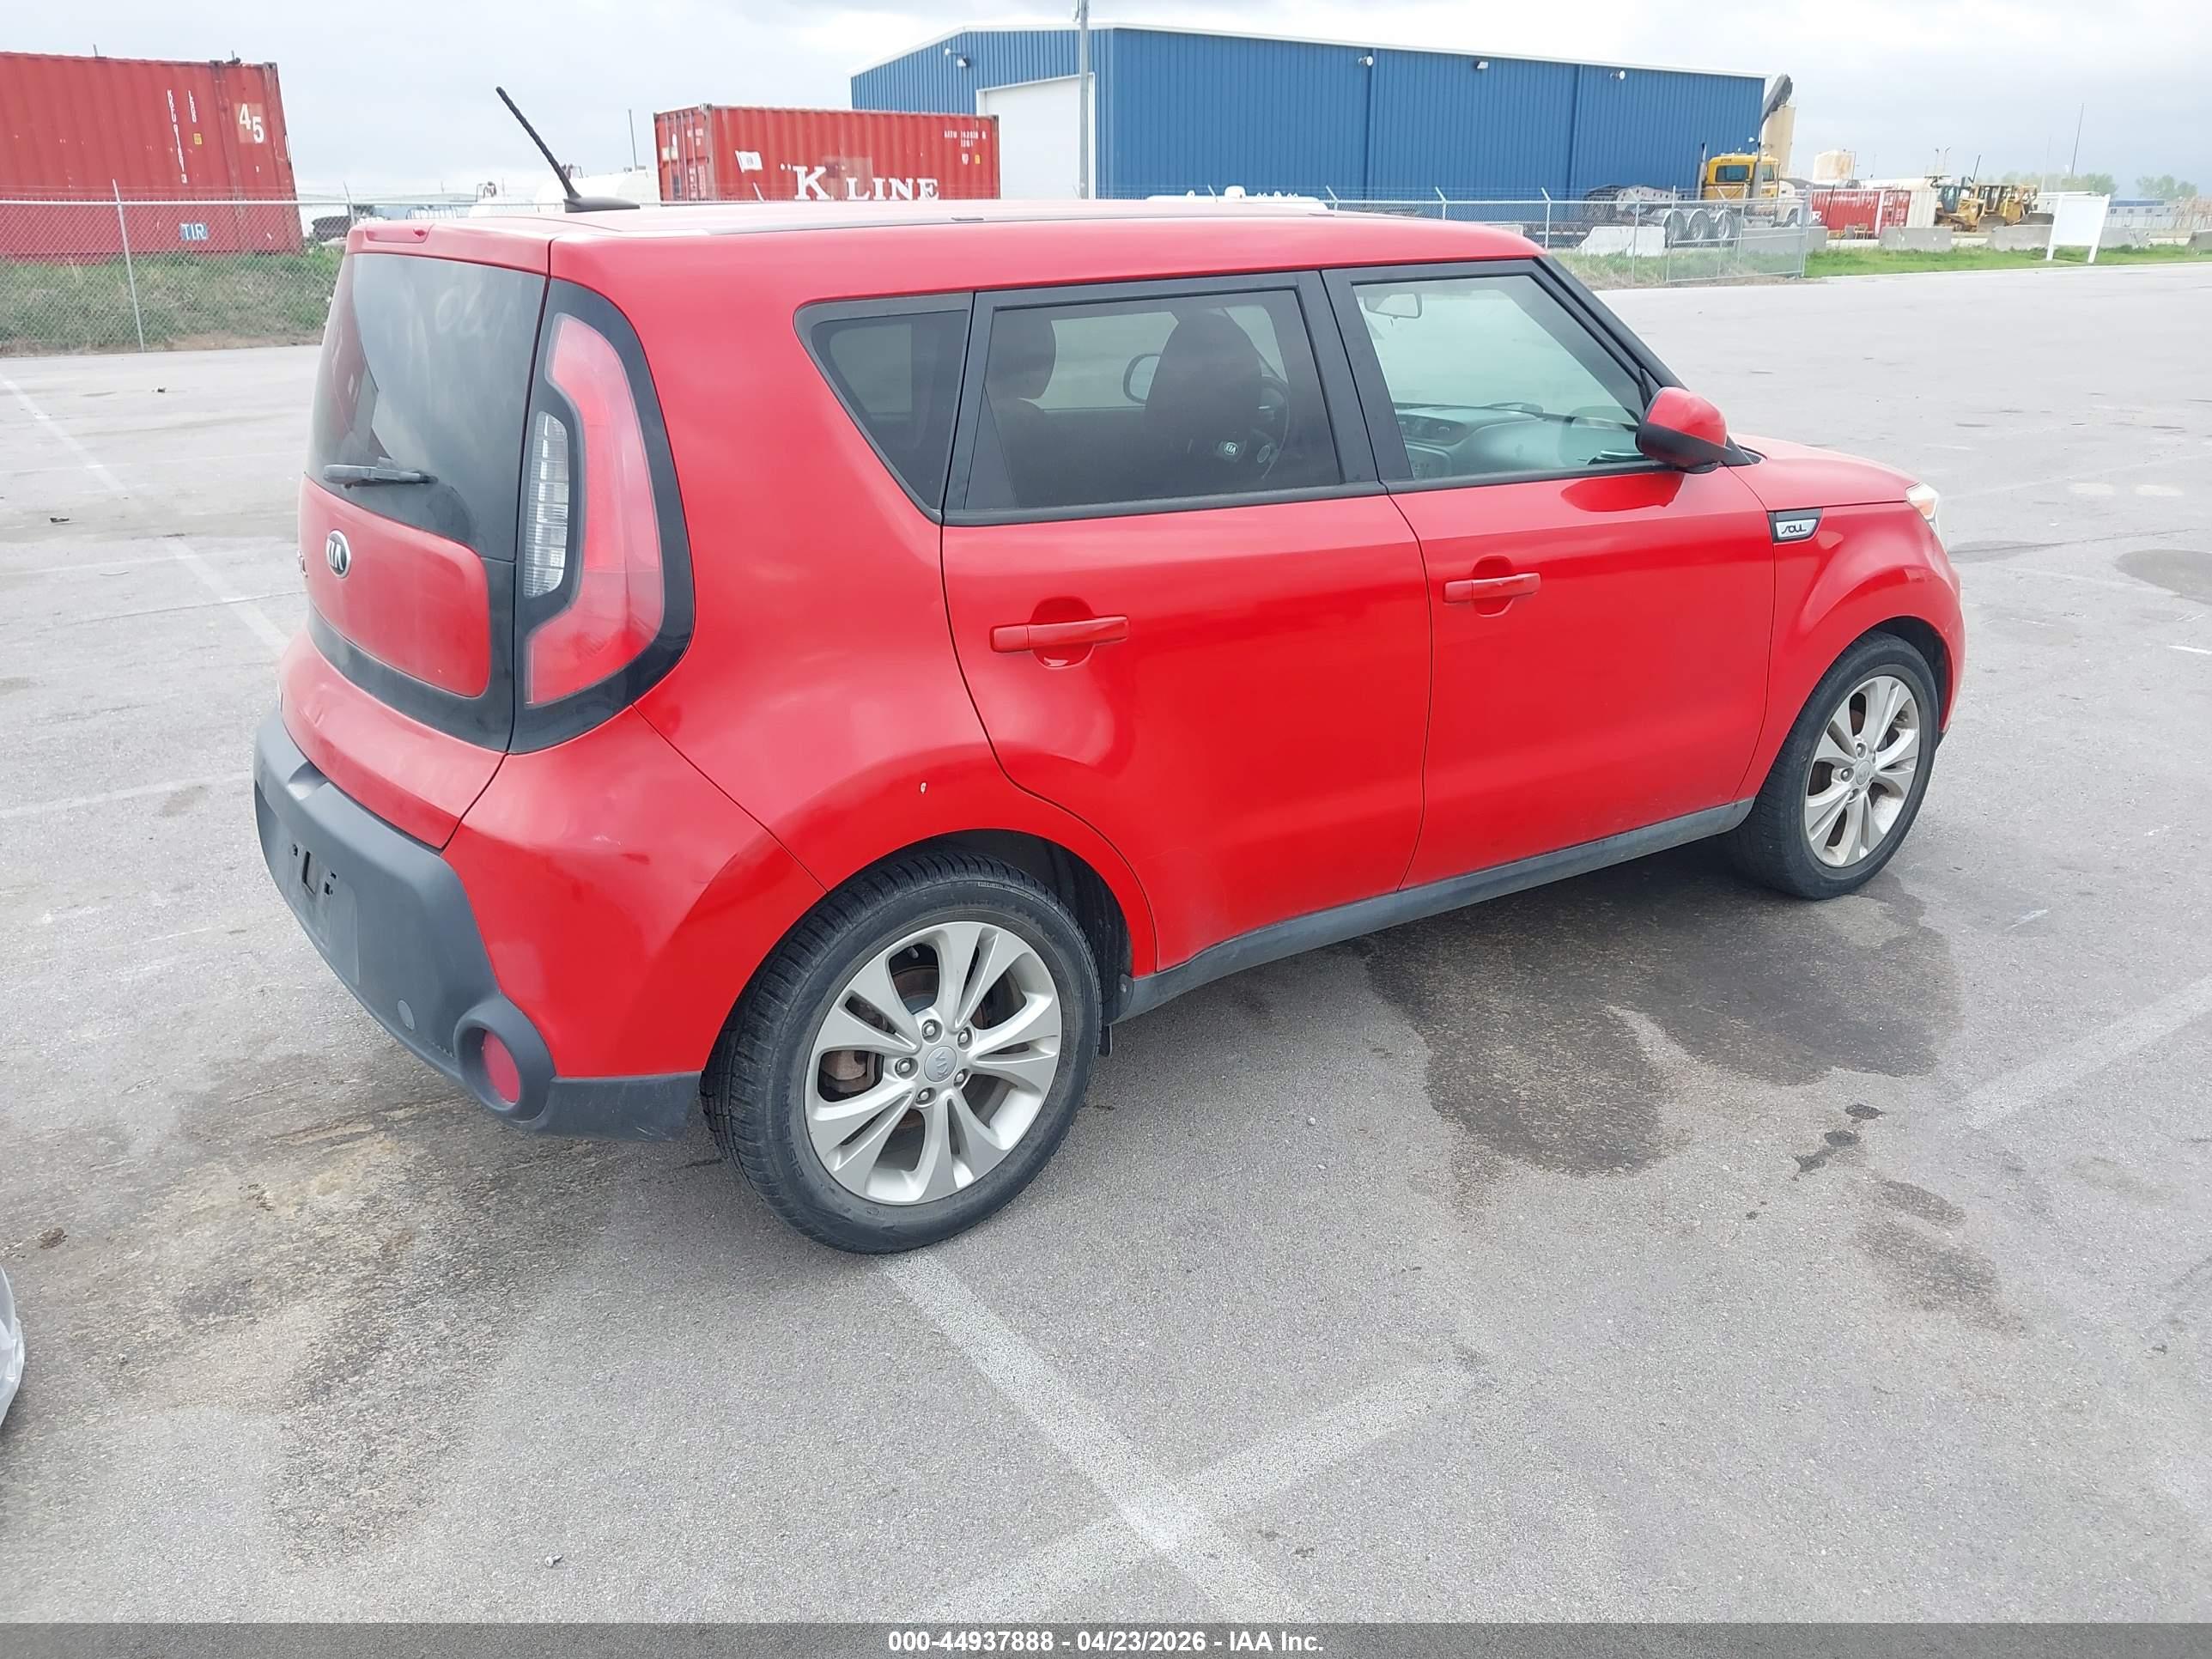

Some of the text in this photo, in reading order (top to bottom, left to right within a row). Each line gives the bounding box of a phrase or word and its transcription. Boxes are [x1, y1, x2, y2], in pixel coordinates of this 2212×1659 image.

[239, 103, 264, 143] 45
[846, 177, 939, 201] LINE
[180, 223, 207, 240] TIR
[1780, 523, 1808, 534] SOUL
